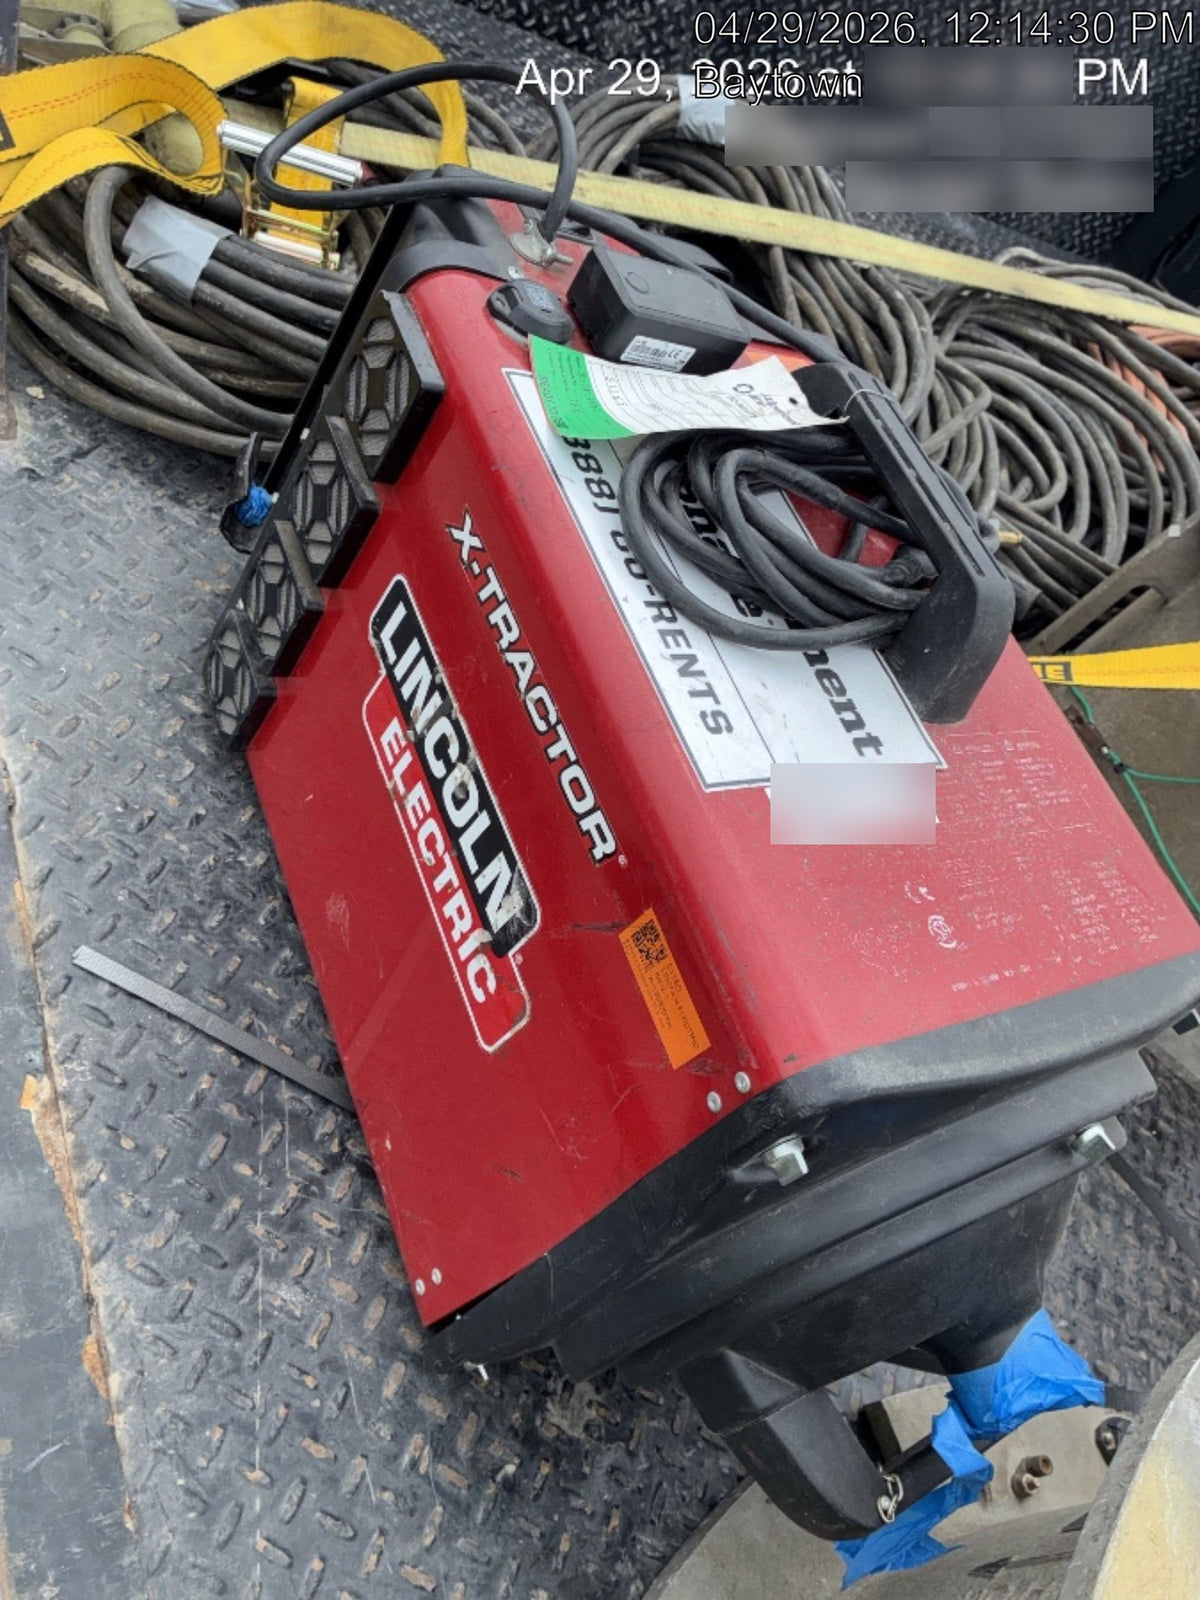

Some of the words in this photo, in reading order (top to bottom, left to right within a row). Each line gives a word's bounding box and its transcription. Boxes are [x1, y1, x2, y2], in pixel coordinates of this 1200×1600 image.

[379, 600, 522, 934] LINCOLN
[446, 507, 617, 863] X-TRACTOR
[380, 715, 497, 1004] ELECTRIC
